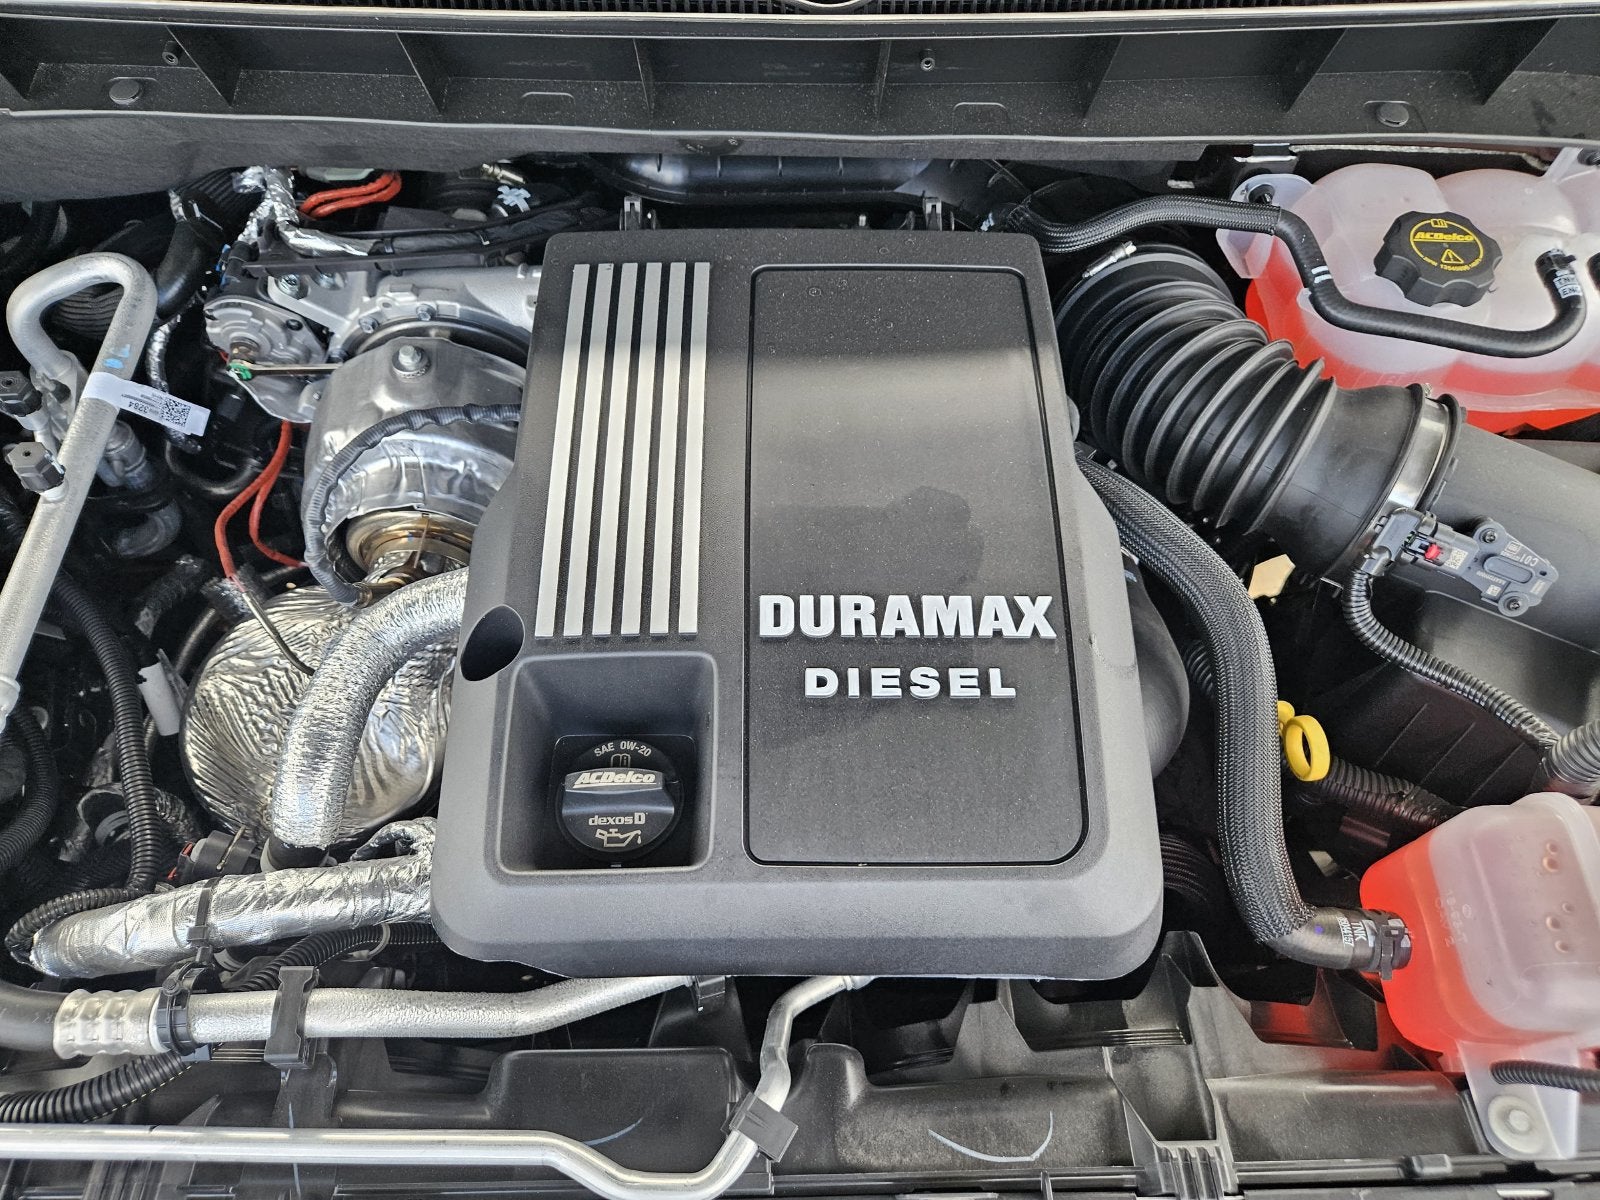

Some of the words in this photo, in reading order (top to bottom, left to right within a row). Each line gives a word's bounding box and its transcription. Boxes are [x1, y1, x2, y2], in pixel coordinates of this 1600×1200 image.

[1414, 231, 1475, 242] ACDelco
[759, 594, 1058, 640] DURAMAX
[804, 666, 1017, 699] DIESEL
[594, 742, 615, 757] SAE
[620, 740, 652, 757] 0W-20
[573, 771, 656, 787] ACDelco
[588, 812, 646, 826] dexosD
[1350, 921, 1368, 941] TNK
